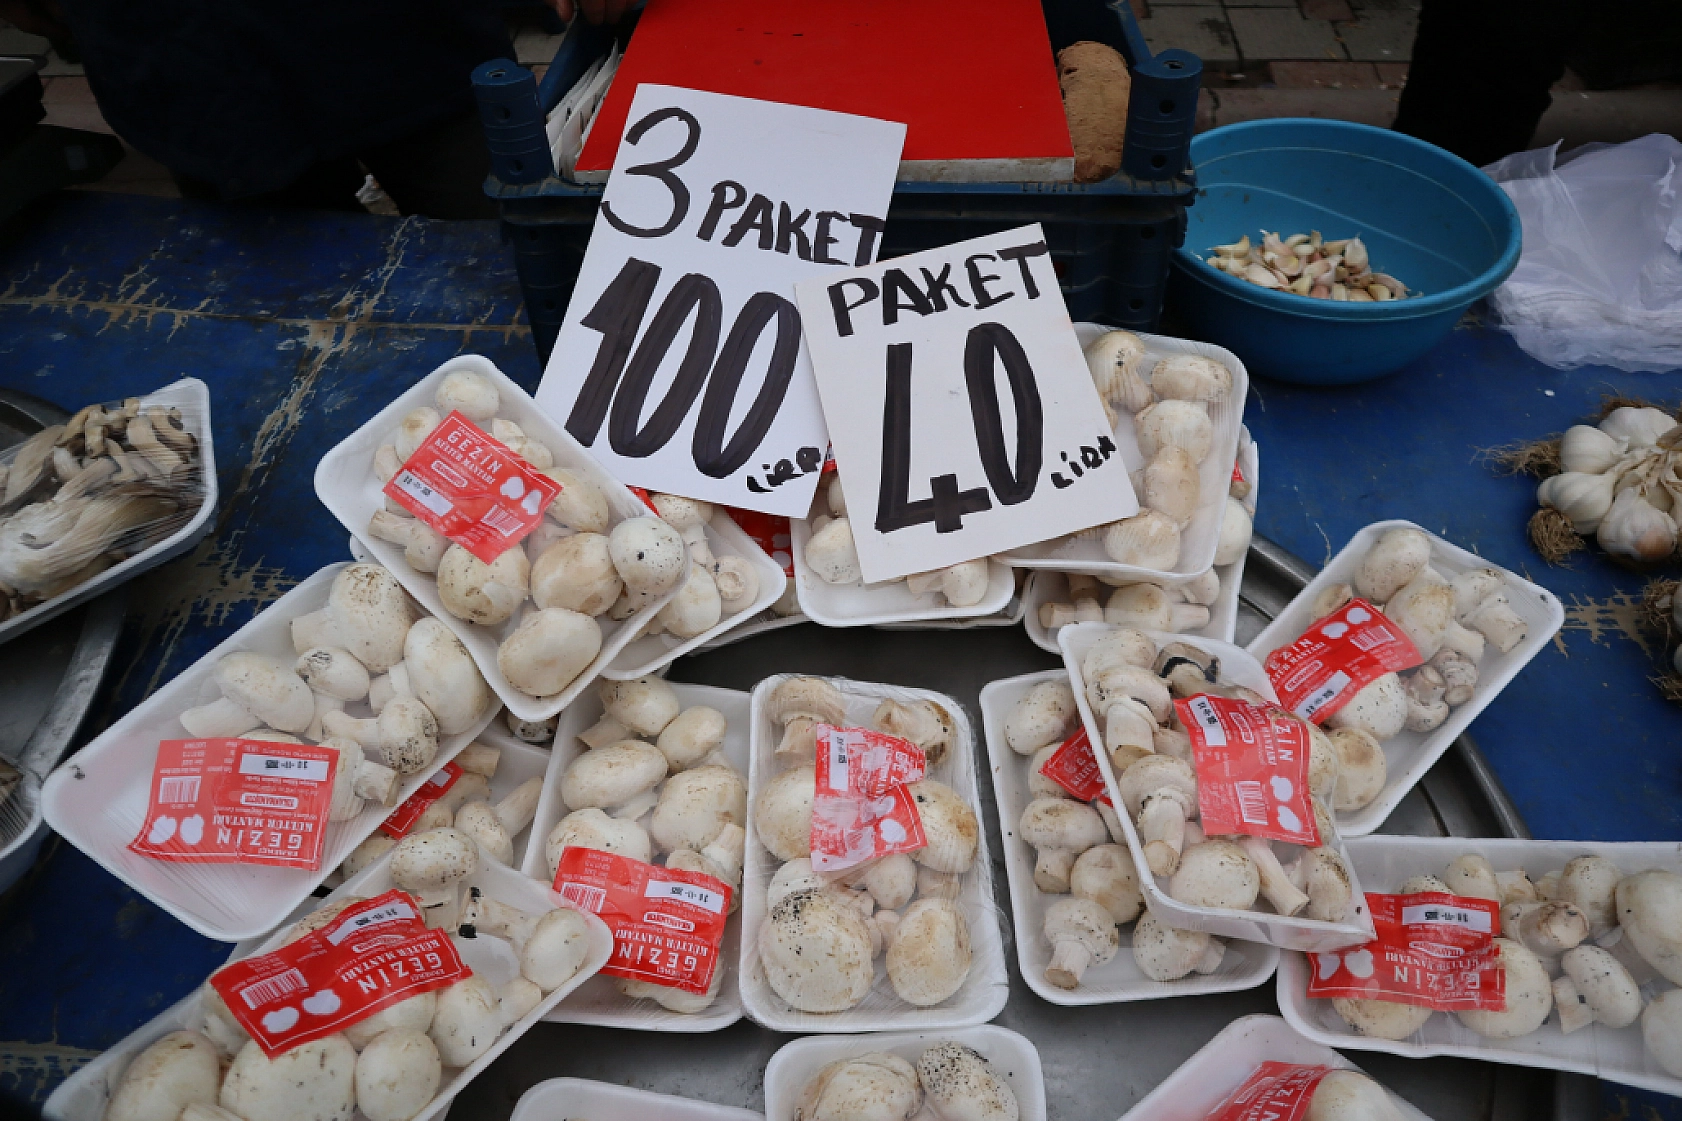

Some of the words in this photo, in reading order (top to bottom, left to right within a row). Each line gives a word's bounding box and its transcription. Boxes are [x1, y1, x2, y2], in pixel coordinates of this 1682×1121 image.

[602, 106, 701, 238] 3
[697, 180, 885, 266] PAKET
[827, 240, 1048, 337] PAKET
[563, 257, 802, 479] 100
[874, 321, 1044, 534] 40
[448, 430, 503, 474] GEZİN
[1269, 638, 1313, 671] EZİN
[211, 808, 264, 828] MANTARI
[266, 817, 313, 832] KÜLTÜR
[214, 827, 302, 850] GEZİN
[340, 950, 397, 983] MANTARI
[617, 940, 697, 973] GEZİN
[357, 952, 443, 995] GEZİN
[1394, 965, 1480, 991] GEZİN
